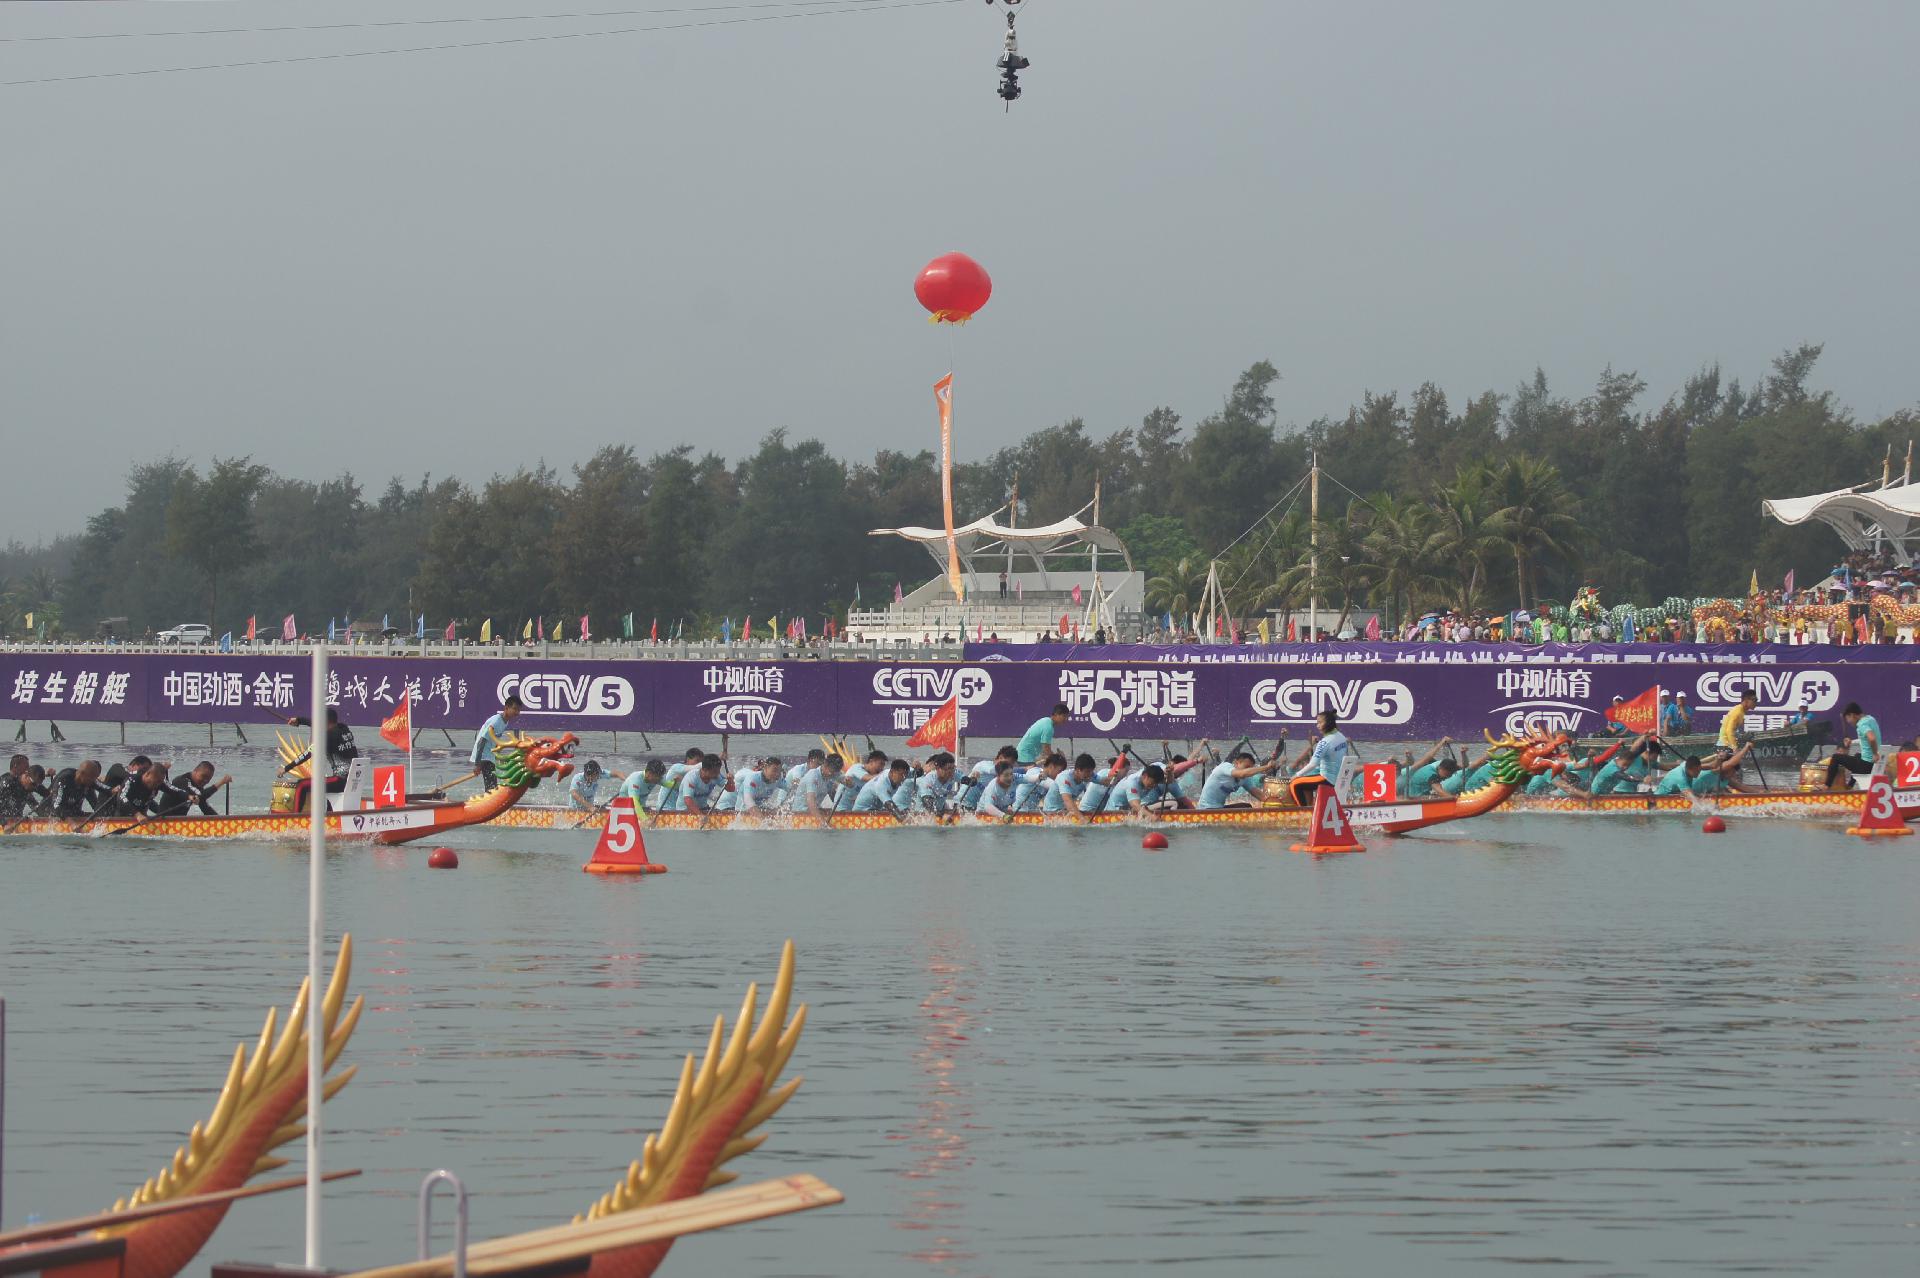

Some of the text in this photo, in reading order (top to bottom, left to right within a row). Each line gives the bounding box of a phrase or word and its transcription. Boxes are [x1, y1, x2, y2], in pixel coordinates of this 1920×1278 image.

[11, 670, 131, 704] 培生船艇
[704, 666, 784, 693] 中视体育
[1497, 668, 1592, 698] 中视体育
[1059, 670, 1196, 731] 第5频道
[711, 704, 777, 729] CCTV
[1505, 711, 1583, 738] CCTV
[1371, 769, 1388, 798] 3
[1905, 757, 1920, 782] 2
[381, 771, 398, 802] 4
[1871, 782, 1894, 819] 3
[607, 807, 636, 853] 5
[1321, 796, 1344, 836] 4
